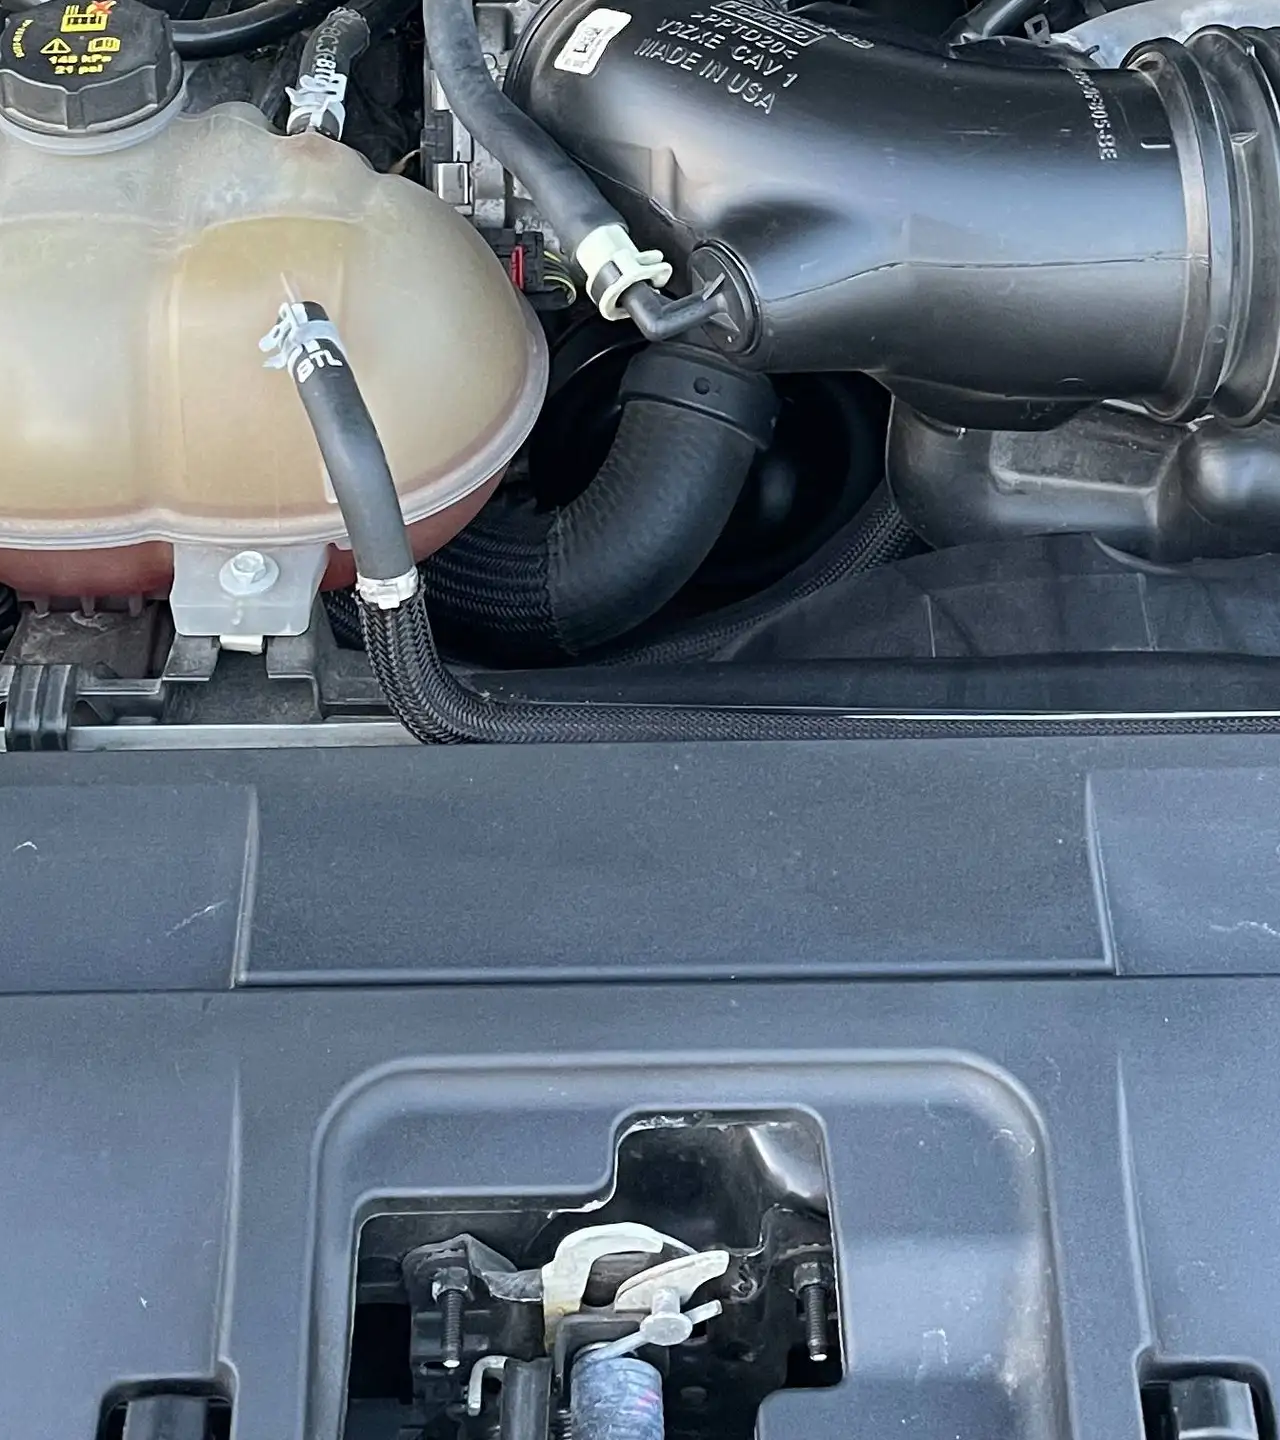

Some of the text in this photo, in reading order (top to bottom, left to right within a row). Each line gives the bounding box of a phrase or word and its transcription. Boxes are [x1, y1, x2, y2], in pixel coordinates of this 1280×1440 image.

[633, 38, 703, 71] MADE
[699, 58, 729, 83] IN
[727, 73, 776, 115] USA
[730, 45, 784, 77] CAV
[782, 73, 799, 88] 1
[297, 349, 343, 383] BTL
